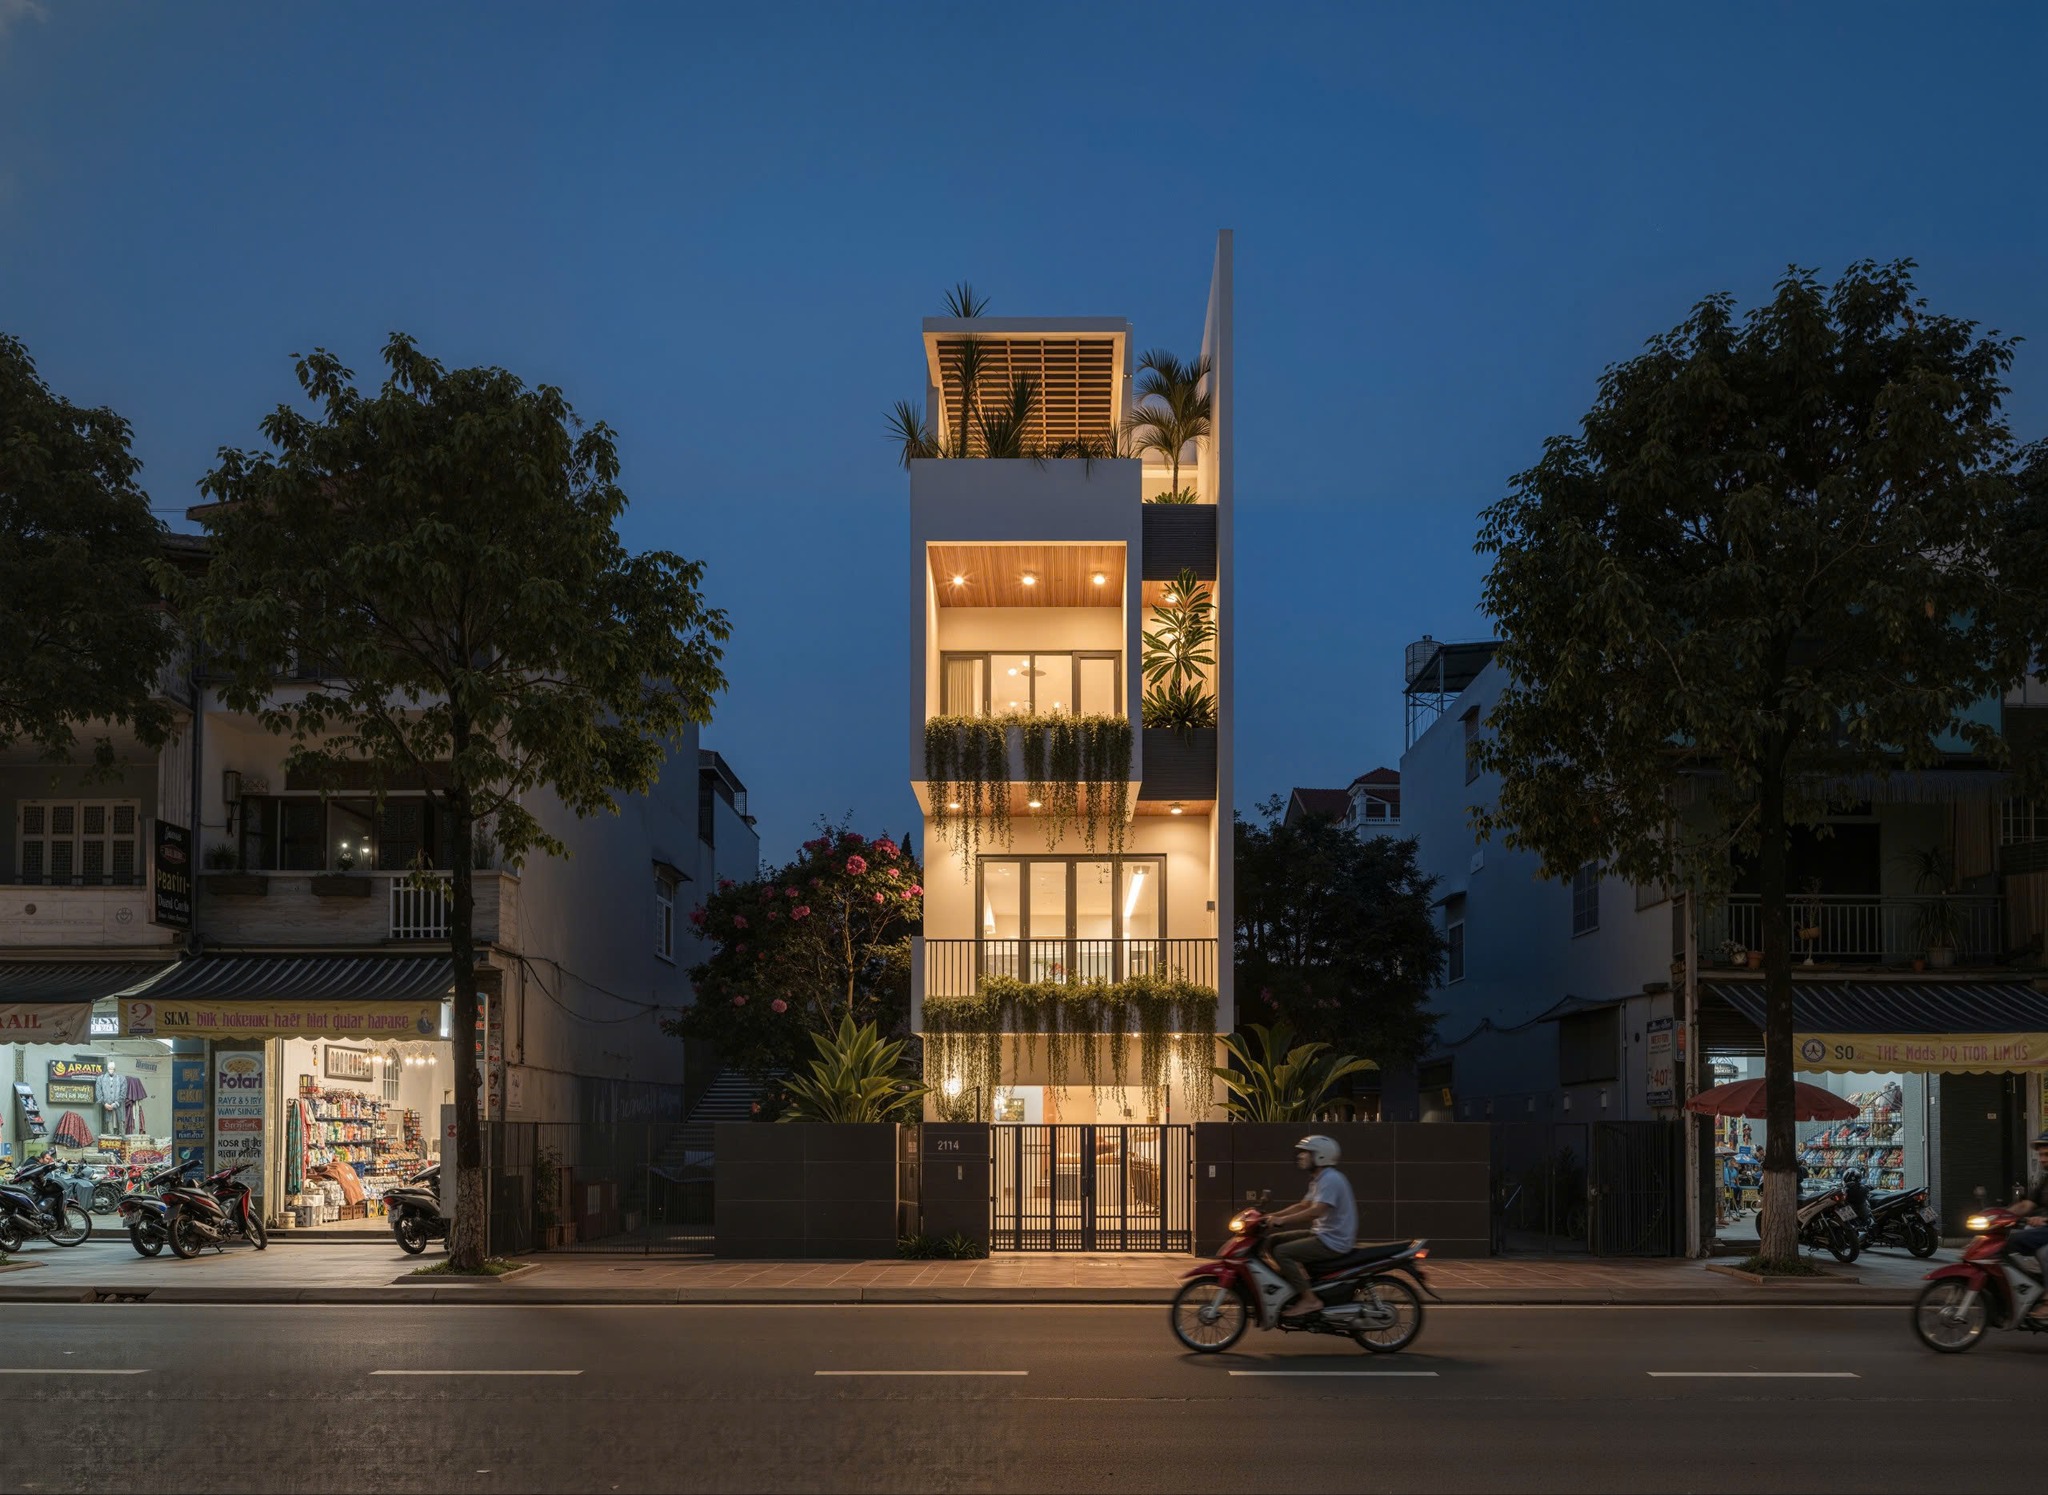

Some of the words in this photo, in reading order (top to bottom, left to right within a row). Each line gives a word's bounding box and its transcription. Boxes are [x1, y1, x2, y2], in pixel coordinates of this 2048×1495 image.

[0, 1014, 42, 1029] AIL
[1876, 1045, 1899, 1061] THE
[937, 1140, 960, 1151] 2114
